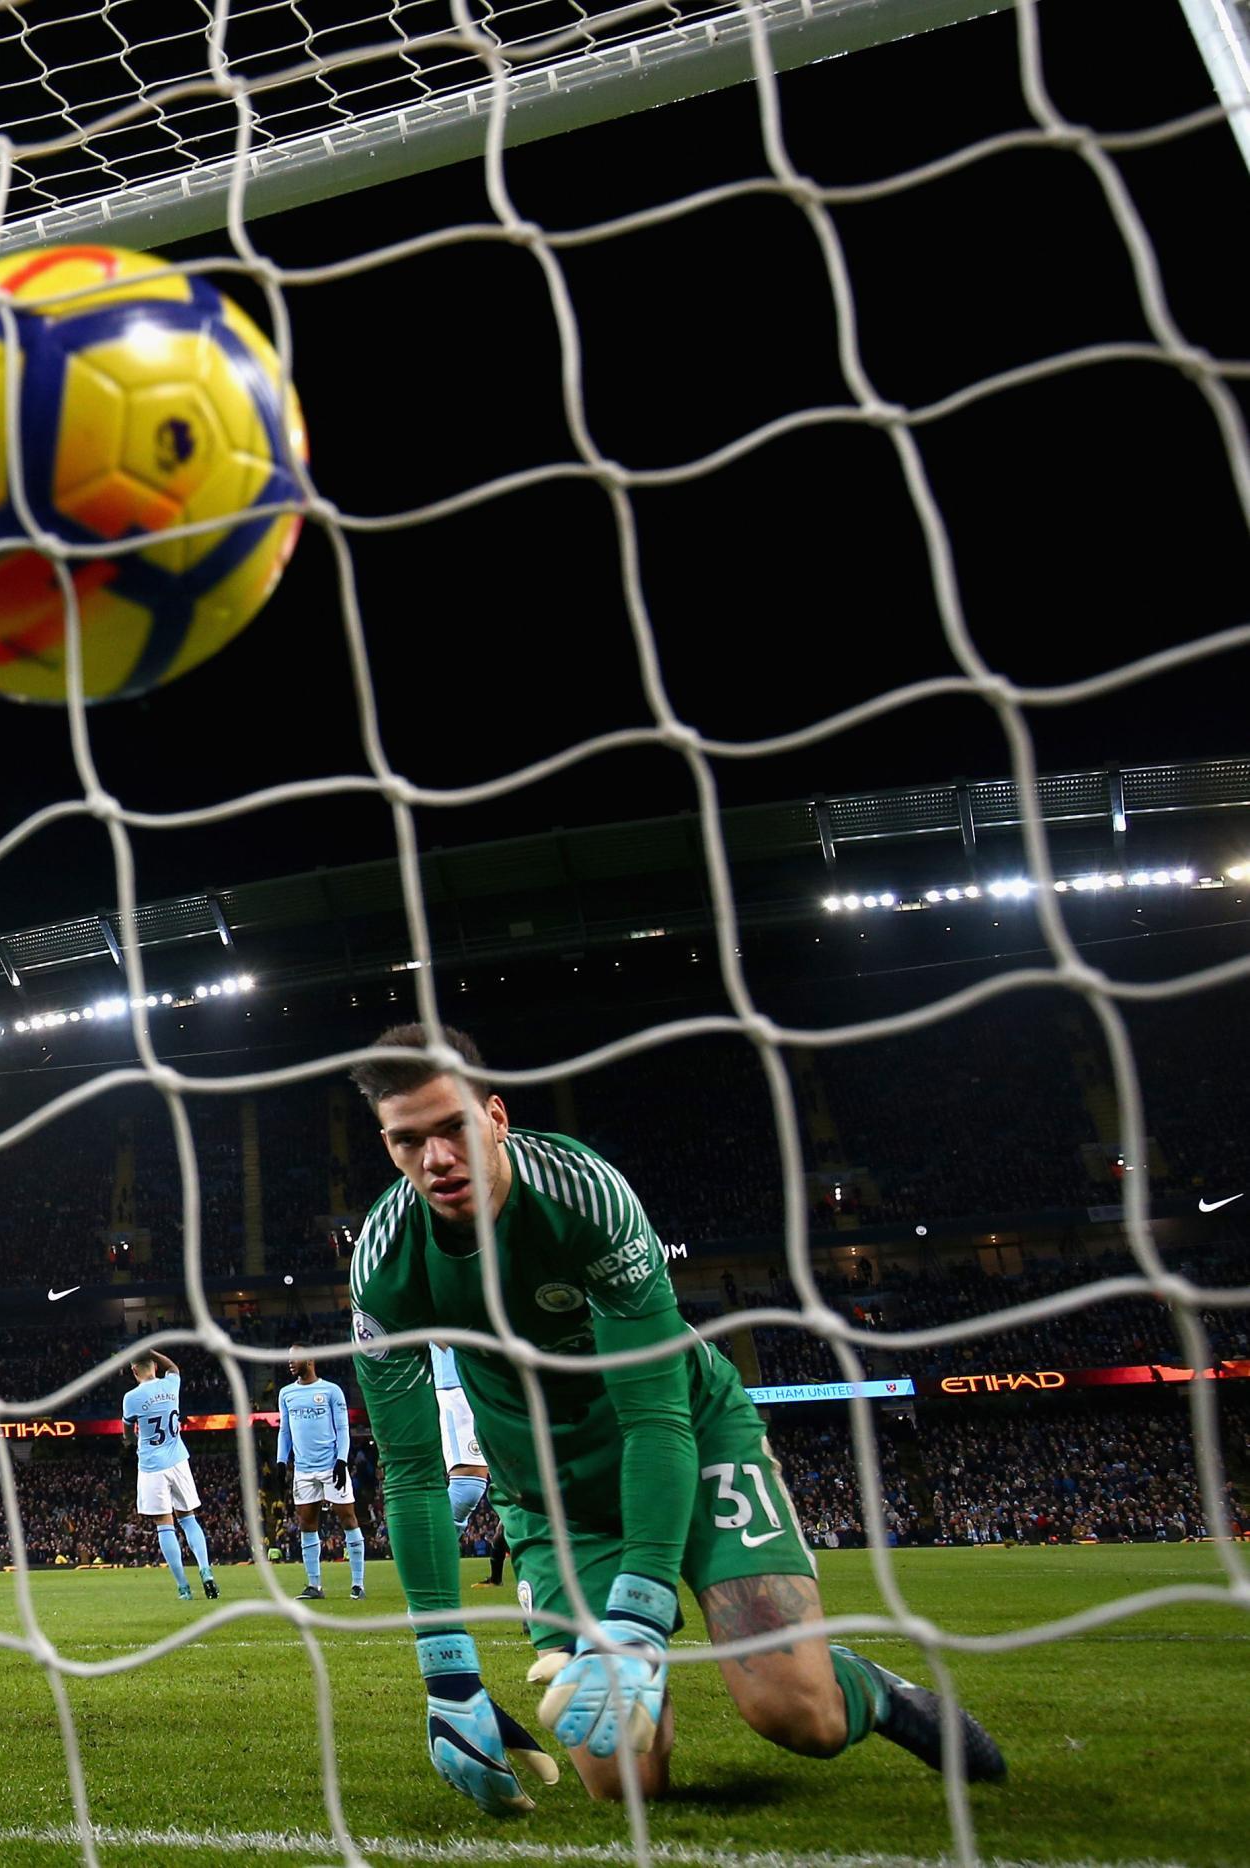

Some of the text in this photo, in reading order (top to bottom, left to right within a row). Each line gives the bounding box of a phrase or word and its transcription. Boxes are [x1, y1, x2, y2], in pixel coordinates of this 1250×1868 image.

[585, 1233, 649, 1280] NEXEN
[607, 1258, 653, 1285] TIRE
[749, 1385, 856, 1401] EST HAM UNITED
[940, 1371, 1066, 1393] ETIHAD
[141, 1393, 176, 1412] OTAMEND
[147, 1409, 179, 1446] 30
[700, 1462, 782, 1530] 31
